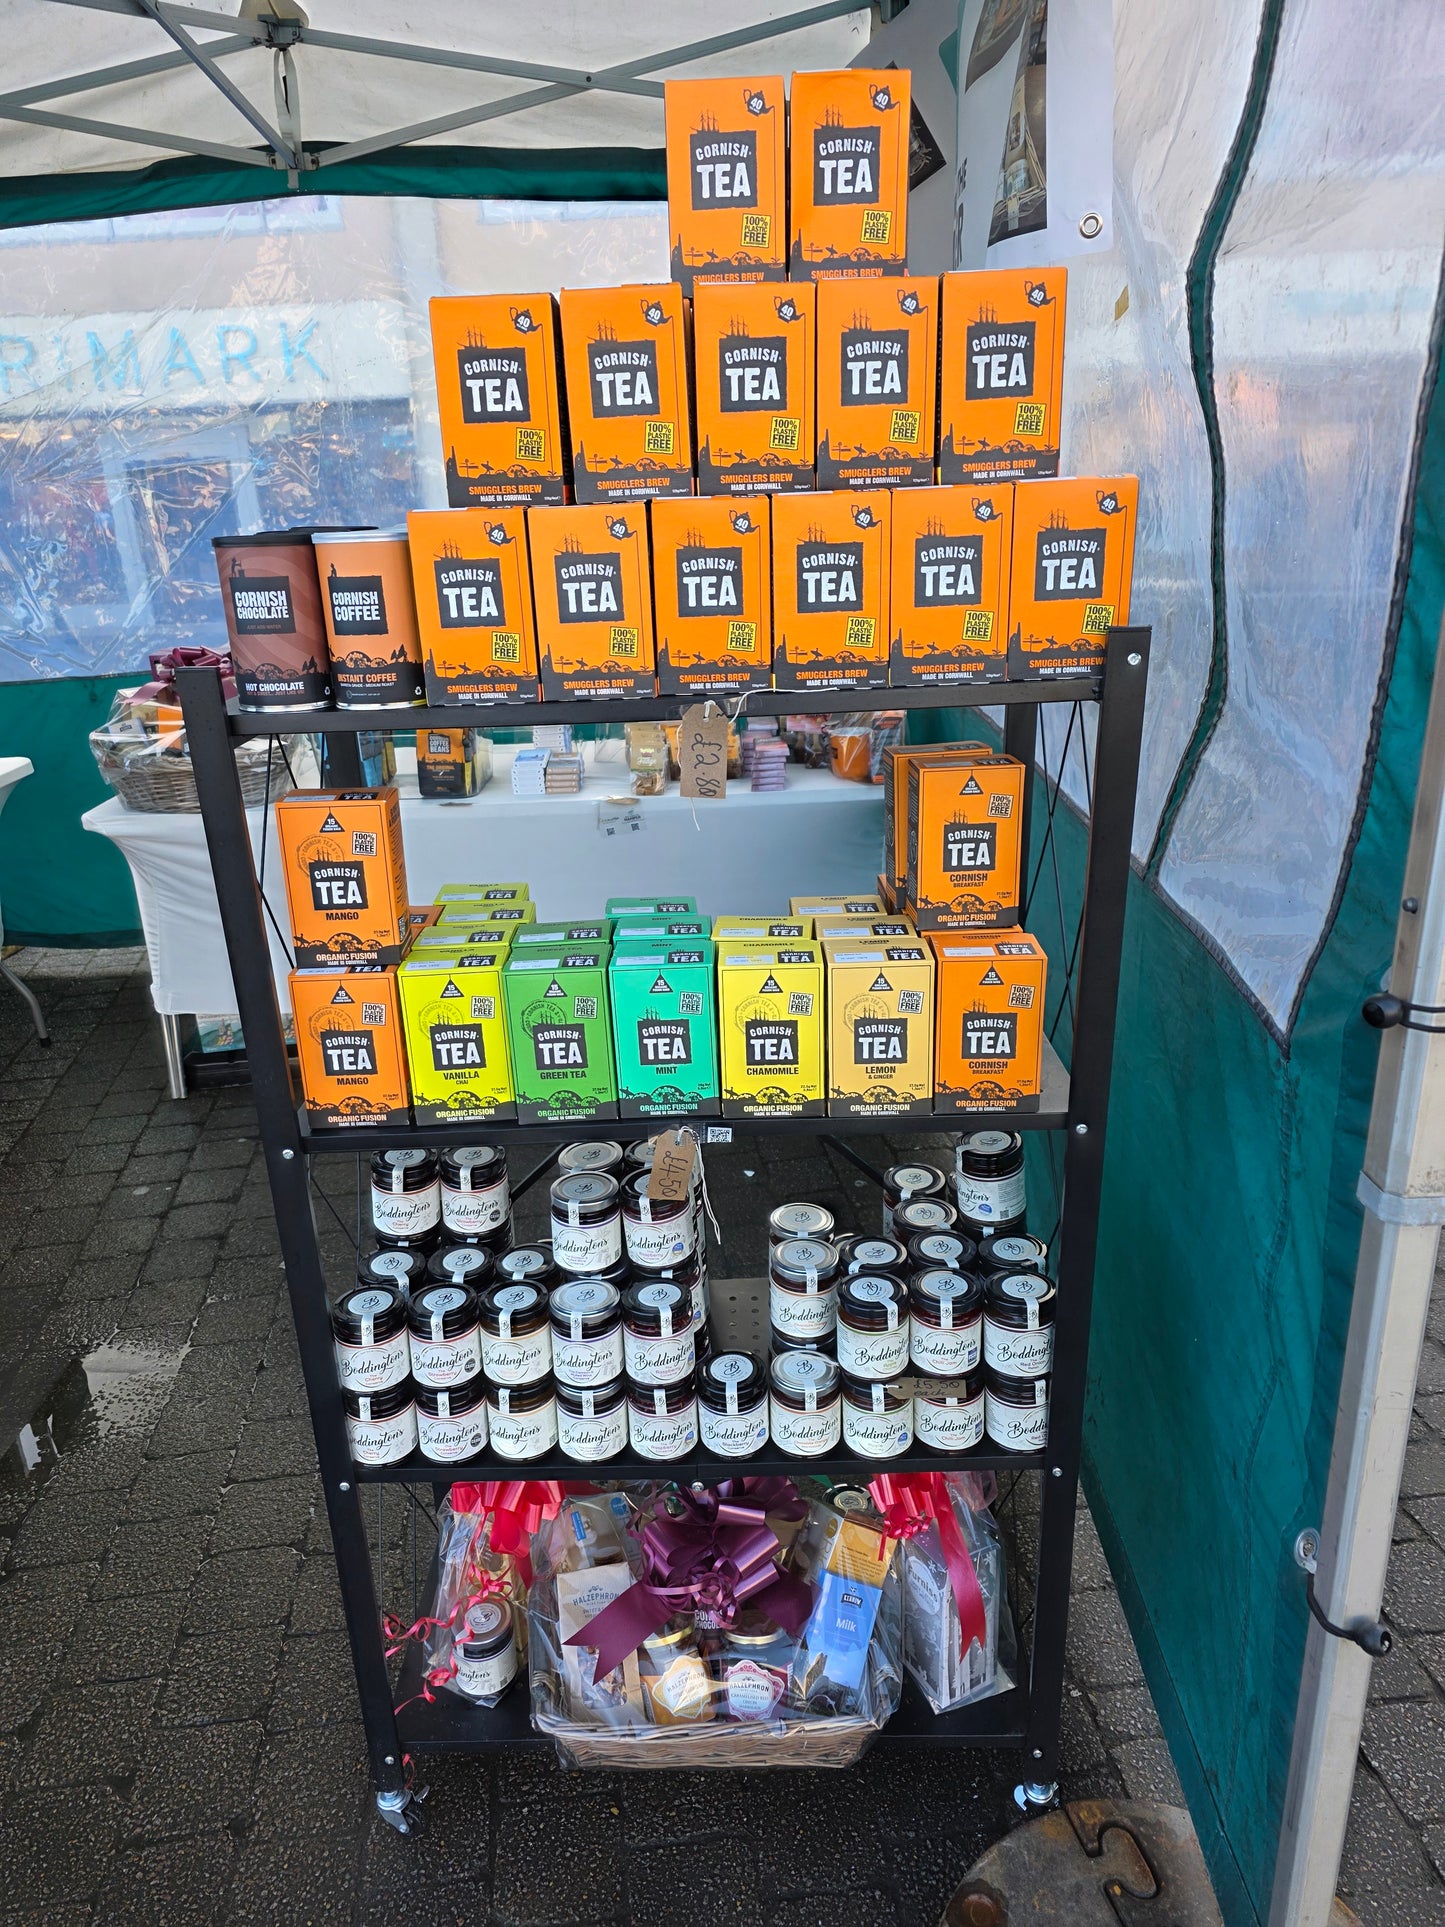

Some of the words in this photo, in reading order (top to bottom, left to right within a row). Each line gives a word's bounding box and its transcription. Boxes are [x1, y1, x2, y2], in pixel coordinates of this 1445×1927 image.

[875, 93, 888, 106] 40
[695, 142, 749, 161] CORNISH
[819, 138, 873, 156] CORNISH
[696, 162, 751, 199] TEA
[819, 158, 873, 195] TEA
[745, 216, 768, 228] 100%
[744, 232, 767, 244] FREE
[692, 273, 740, 284] SMUGGLERS
[741, 272, 764, 282] BREW
[811, 269, 858, 279] SMUGGLERS
[859, 268, 883, 278] BREW
[780, 305, 794, 317] 40
[972, 333, 1027, 352] CORNISH
[846, 341, 901, 358] CORNISH
[594, 352, 649, 370] CORNISH
[724, 347, 779, 365] CORNISH
[464, 358, 518, 376] CORNISH
[972, 352, 1027, 389] TEA
[847, 360, 901, 395] TEA
[596, 371, 653, 407] TEA
[725, 367, 780, 402] TEA
[466, 378, 523, 413] TEA
[774, 419, 797, 430] 100%
[773, 427, 797, 438] PLASTIC
[772, 435, 796, 446] FREE
[962, 460, 1011, 472] SMUGGLERS
[1012, 459, 1036, 469] BREW
[839, 467, 887, 478] SMUGGLERS
[888, 466, 912, 476] BREW
[597, 478, 645, 490] SMUGGLERS
[646, 477, 670, 487] BREW
[720, 474, 768, 484] SMUGGLERS
[769, 473, 793, 482] BREW
[469, 485, 517, 494] SMUGGLERS
[518, 484, 542, 493] BREW
[1042, 539, 1098, 556] CORNISH
[802, 552, 856, 569] CORNISH
[920, 546, 975, 563] CORNISH
[560, 563, 613, 579] CORNISH
[682, 557, 735, 573] CORNISH
[440, 568, 493, 585] CORNISH
[920, 563, 975, 597] TEA
[1042, 557, 1096, 591] TEA
[683, 575, 737, 607] TEA
[802, 570, 857, 603] TEA
[235, 590, 288, 607] CORNISH
[332, 591, 379, 605] CORNISH
[442, 586, 499, 618] TEA
[562, 580, 618, 613] TEA
[237, 606, 290, 620] CHOCOLATE
[334, 605, 381, 621] COFFEE
[912, 664, 960, 673] SMUGGLERS
[961, 663, 985, 672] BREW
[1029, 658, 1078, 668] SMUGGLERS
[1079, 657, 1104, 666] BREW
[337, 674, 364, 683] INSTANT
[365, 672, 397, 682] COFFEE
[679, 673, 726, 683] SMUGGLERS
[727, 673, 750, 681] BREW
[796, 670, 843, 680] SMUGGLERS
[844, 669, 868, 678] BREW
[245, 683, 258, 691] HOT
[259, 681, 305, 691] CHOCOLATE
[447, 684, 494, 693] SMUGGLERS
[494, 683, 517, 692] BREW
[563, 679, 610, 689] SMUGGLERS
[611, 678, 634, 687] BREW
[691, 733, 722, 797] £2.80
[355, 833, 377, 842] 100%
[948, 829, 990, 841] CORNISH
[354, 842, 374, 853] FREE
[948, 842, 990, 866] TEA
[314, 867, 358, 879] CORNISH
[949, 873, 988, 883] CORNISH
[316, 881, 363, 905] TEA
[326, 912, 359, 921] MANGO
[937, 914, 970, 923] ORGANIC
[970, 913, 997, 922] FUSION
[316, 953, 350, 962] ORGANIC
[350, 952, 378, 961] FUSION
[792, 994, 813, 1002] 100%
[791, 1003, 810, 1013] FREE
[858, 1024, 901, 1035] CORNISH
[967, 1019, 1011, 1029] CORNISH
[434, 1030, 477, 1042] CORNISH
[537, 1030, 579, 1041] CORNISH
[642, 1025, 684, 1036] CORNISH
[750, 1026, 792, 1037] CORNISH
[325, 1036, 368, 1047] CORNISH
[967, 1031, 1011, 1054] TEA
[436, 1042, 481, 1065] TEA
[539, 1042, 583, 1064] TEA
[643, 1037, 686, 1060] TEA
[750, 1038, 793, 1060] TEA
[858, 1037, 902, 1059] TEA
[327, 1048, 372, 1071] TEA
[968, 1060, 1008, 1070] CORNISH
[443, 1071, 480, 1080] VANILLA
[539, 1071, 569, 1080] GREEN
[569, 1070, 587, 1079] TEA
[655, 1066, 678, 1075] MINT
[746, 1066, 799, 1075] CHAMOMILE
[865, 1065, 896, 1075] LEMON
[336, 1077, 369, 1086] MANGO
[640, 1104, 672, 1112] ORGANIC
[672, 1103, 698, 1111] FUSION
[743, 1105, 776, 1113] ORGANIC
[776, 1105, 802, 1113] FUSION
[850, 1104, 883, 1113] ORGANIC
[883, 1104, 910, 1112] FUSION
[955, 1100, 989, 1108] ORGANIC
[989, 1100, 1017, 1108] FUSION
[327, 1115, 361, 1123] ORGANIC
[360, 1114, 387, 1122] FUSION
[436, 1109, 469, 1119] ORGANIC
[468, 1108, 495, 1117] FUSION
[537, 1109, 570, 1118] ORGANIC
[569, 1108, 596, 1116] FUSION
[658, 1150, 688, 1197] £4.50
[913, 1379, 960, 1390] £5.50
[835, 1617, 857, 1632] Milk
